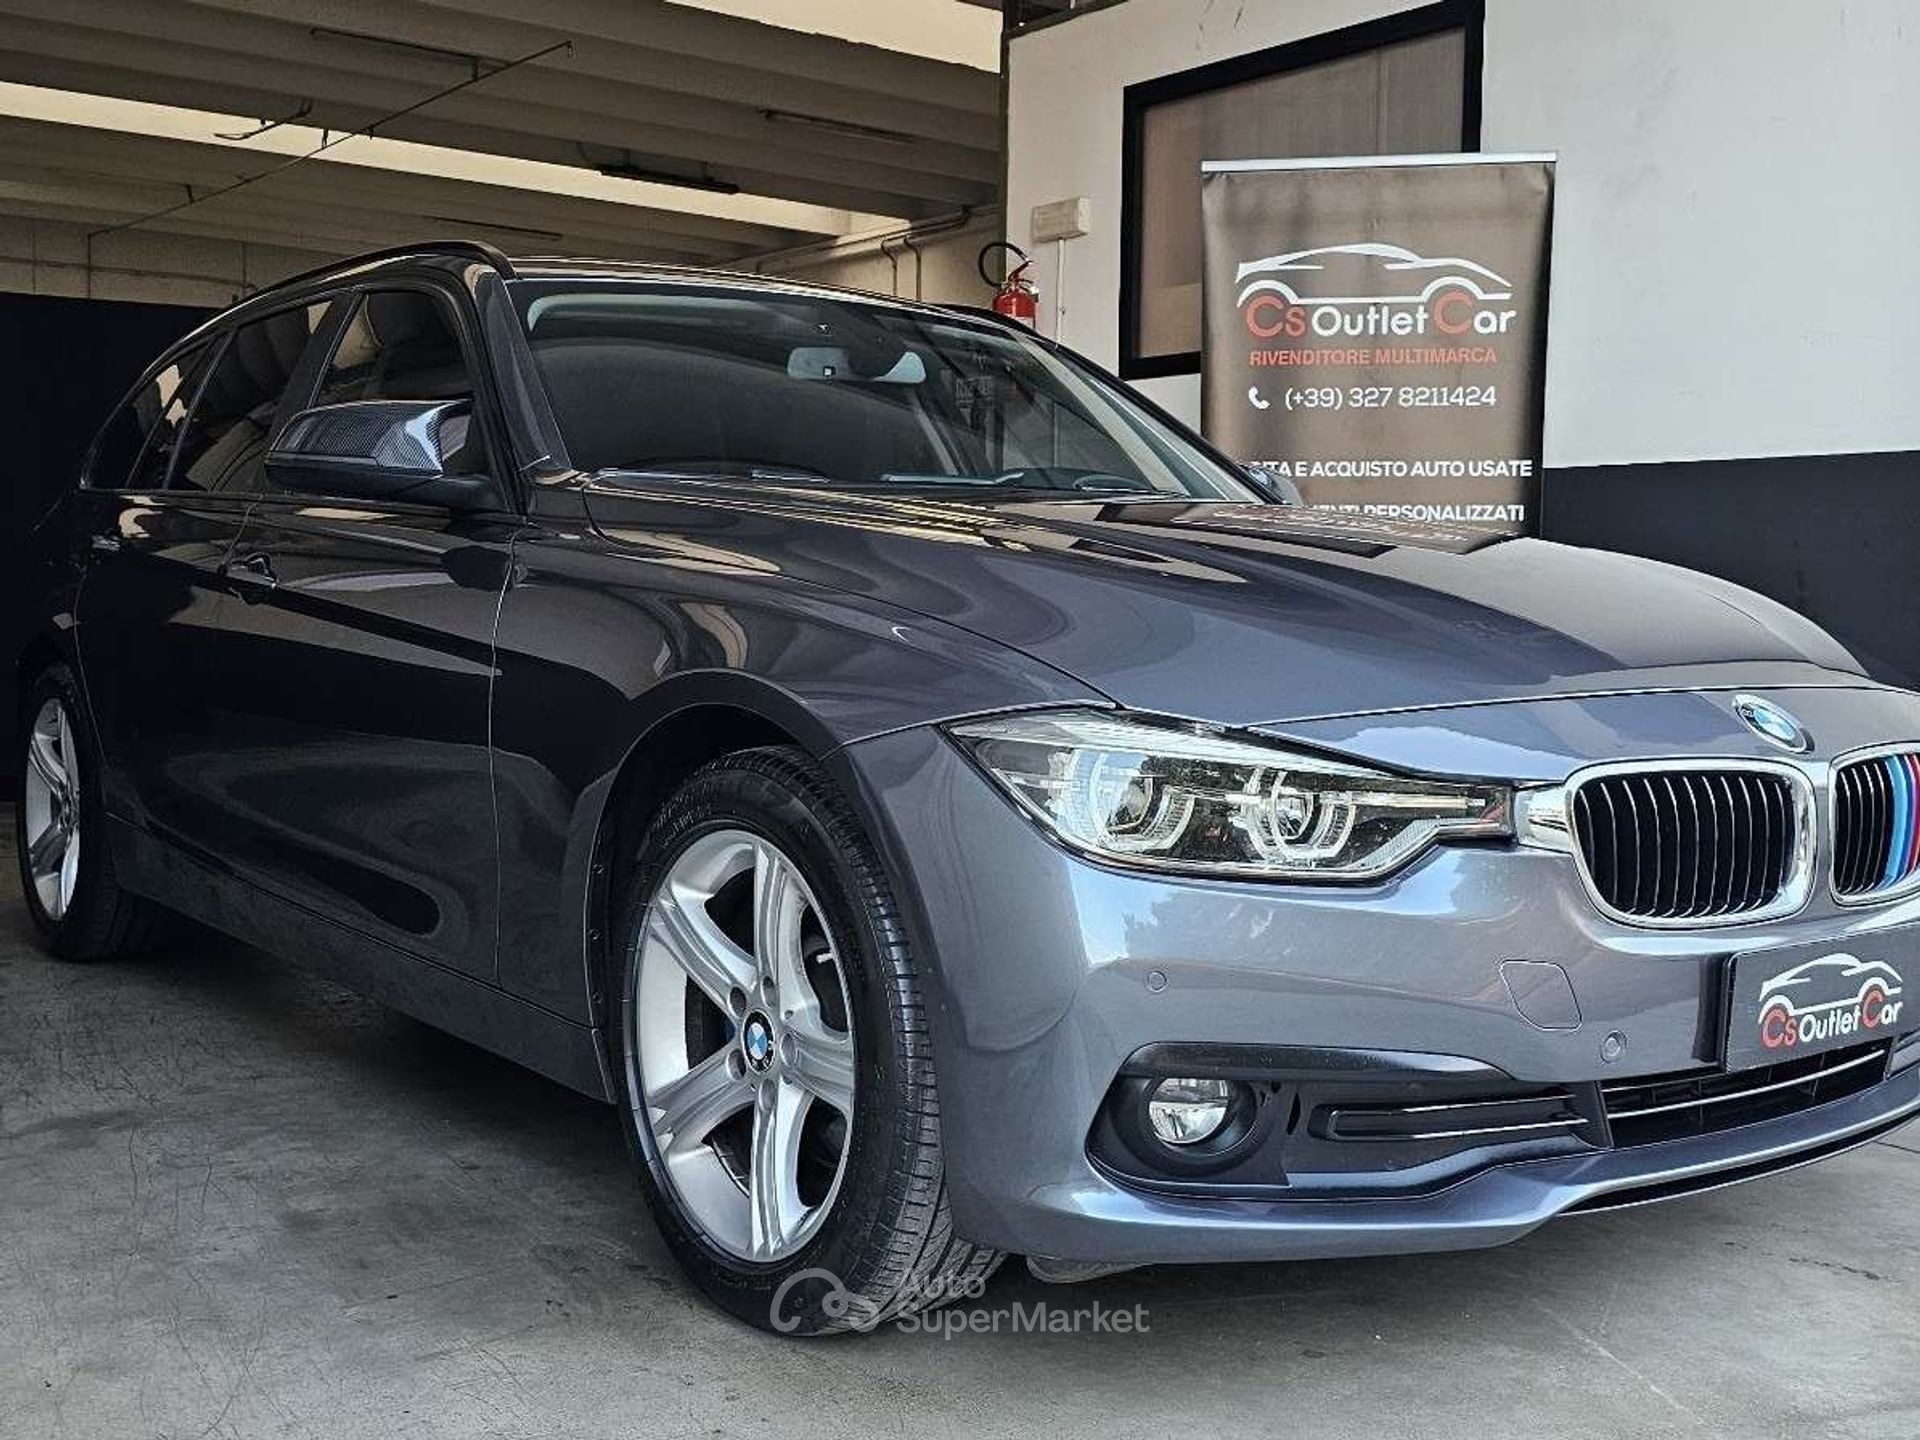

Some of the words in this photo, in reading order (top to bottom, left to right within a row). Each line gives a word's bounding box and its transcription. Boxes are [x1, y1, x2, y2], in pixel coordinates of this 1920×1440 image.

[1250, 350, 1370, 366] RIVENDITORE
[1375, 347, 1498, 365] MULTIMARCA
[1284, 387, 1343, 411] (+39)
[1349, 387, 1393, 408] 327
[1398, 385, 1498, 408] 8211424
[1295, 460, 1308, 477] E
[1309, 460, 1408, 478] ACQUISTO
[1410, 460, 1465, 478] AUTO
[1468, 459, 1533, 477] USATE
